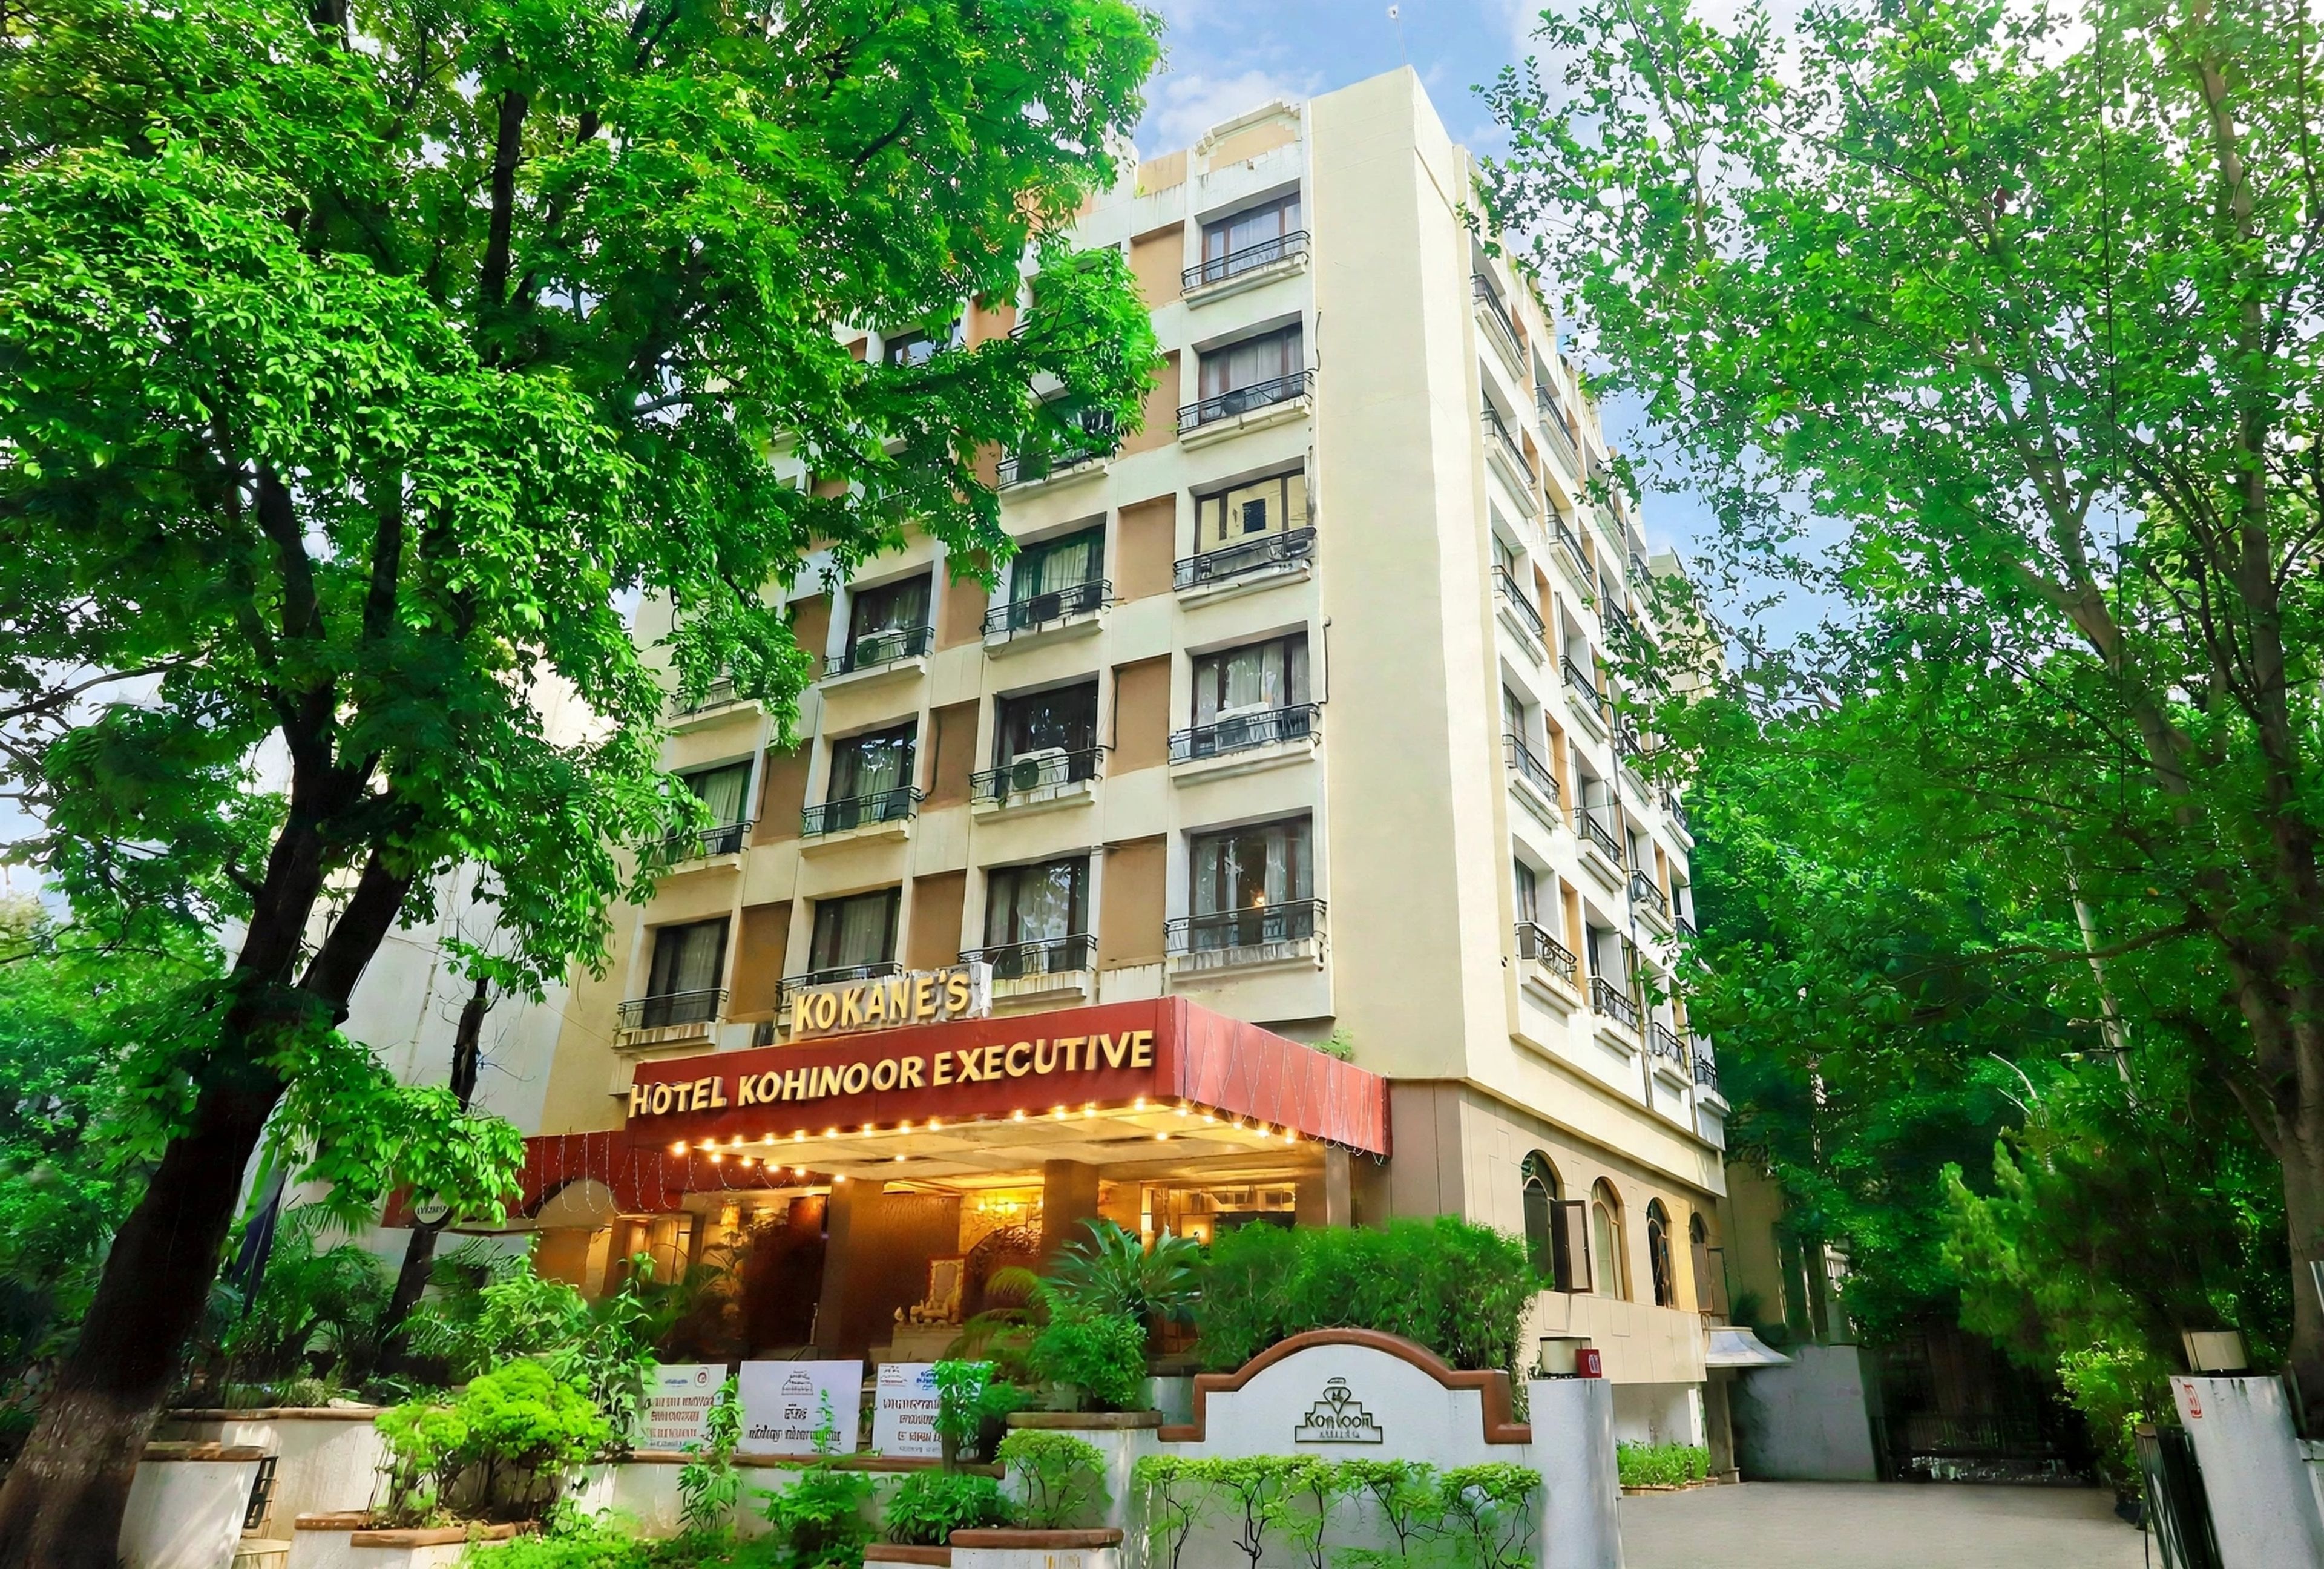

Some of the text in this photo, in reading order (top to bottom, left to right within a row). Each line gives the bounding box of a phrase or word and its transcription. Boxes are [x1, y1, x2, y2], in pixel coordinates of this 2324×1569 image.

[795, 970, 971, 1032] KOKANE'S
[628, 1030, 1154, 1119] HOTEL KOHINOOR EXECUTIVE
